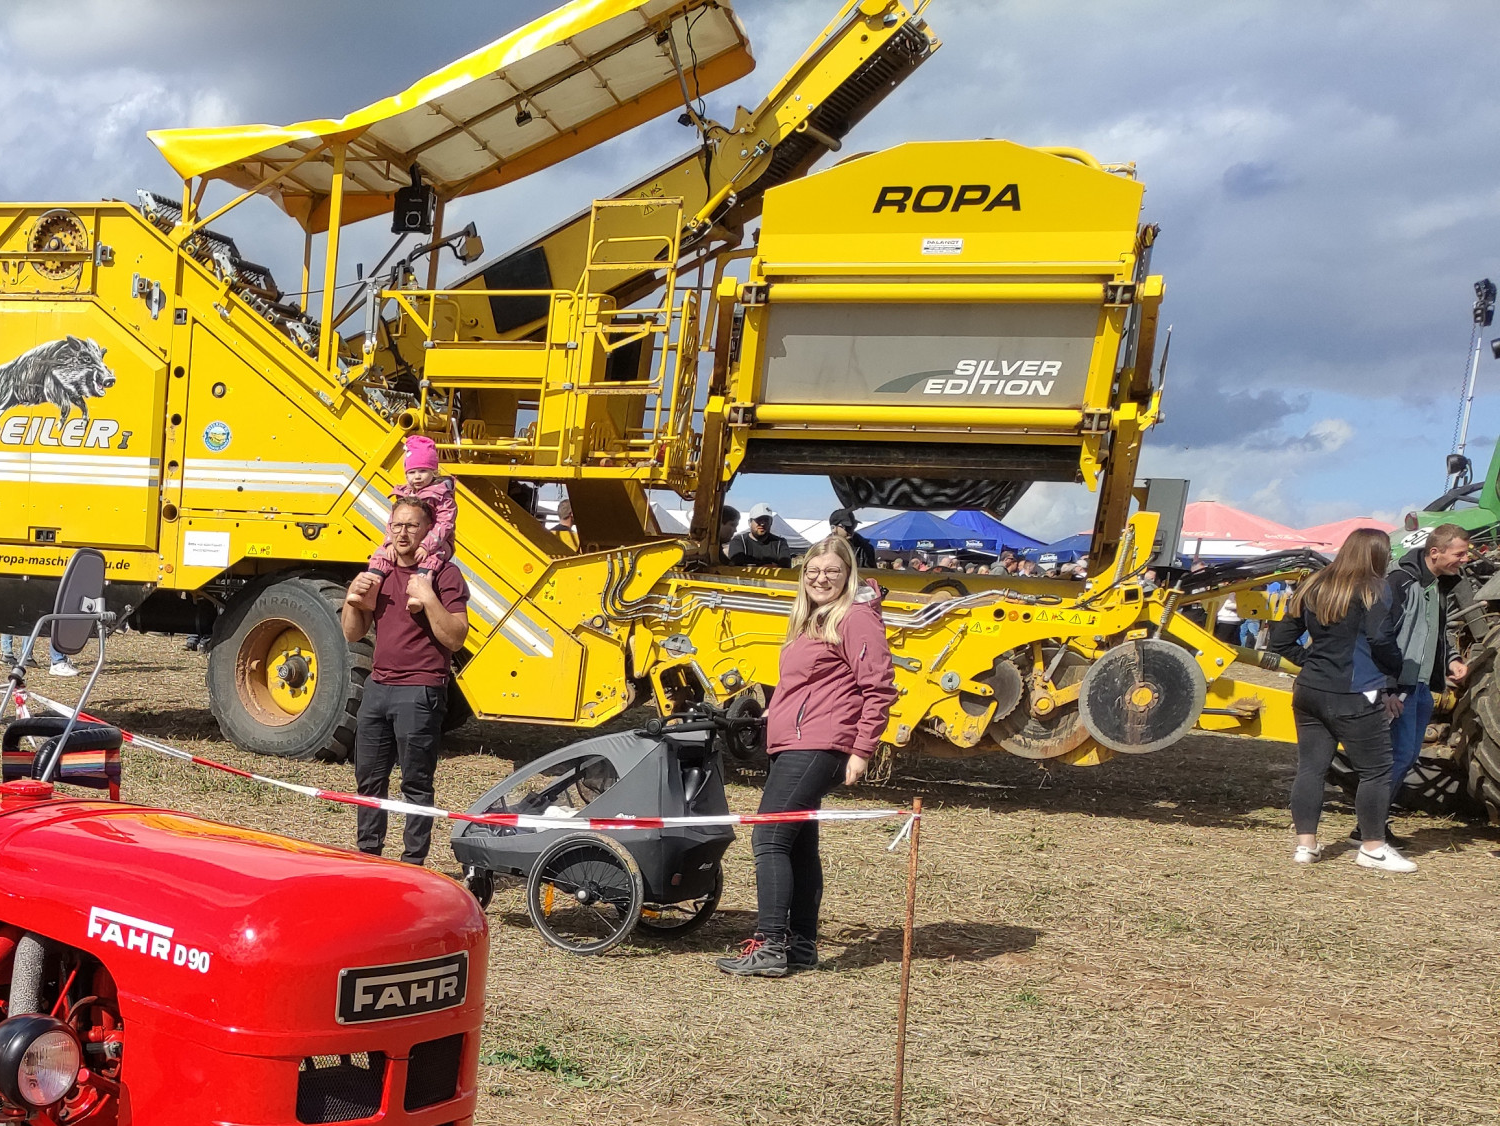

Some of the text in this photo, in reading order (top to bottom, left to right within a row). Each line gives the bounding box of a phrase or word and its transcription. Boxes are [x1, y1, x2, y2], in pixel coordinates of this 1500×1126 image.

[872, 183, 1021, 213] ROPA
[954, 359, 1063, 377] SILVER
[923, 378, 1055, 396] EDITION
[86, 905, 211, 974] FAHR D90
[353, 963, 460, 1013] FAHR
